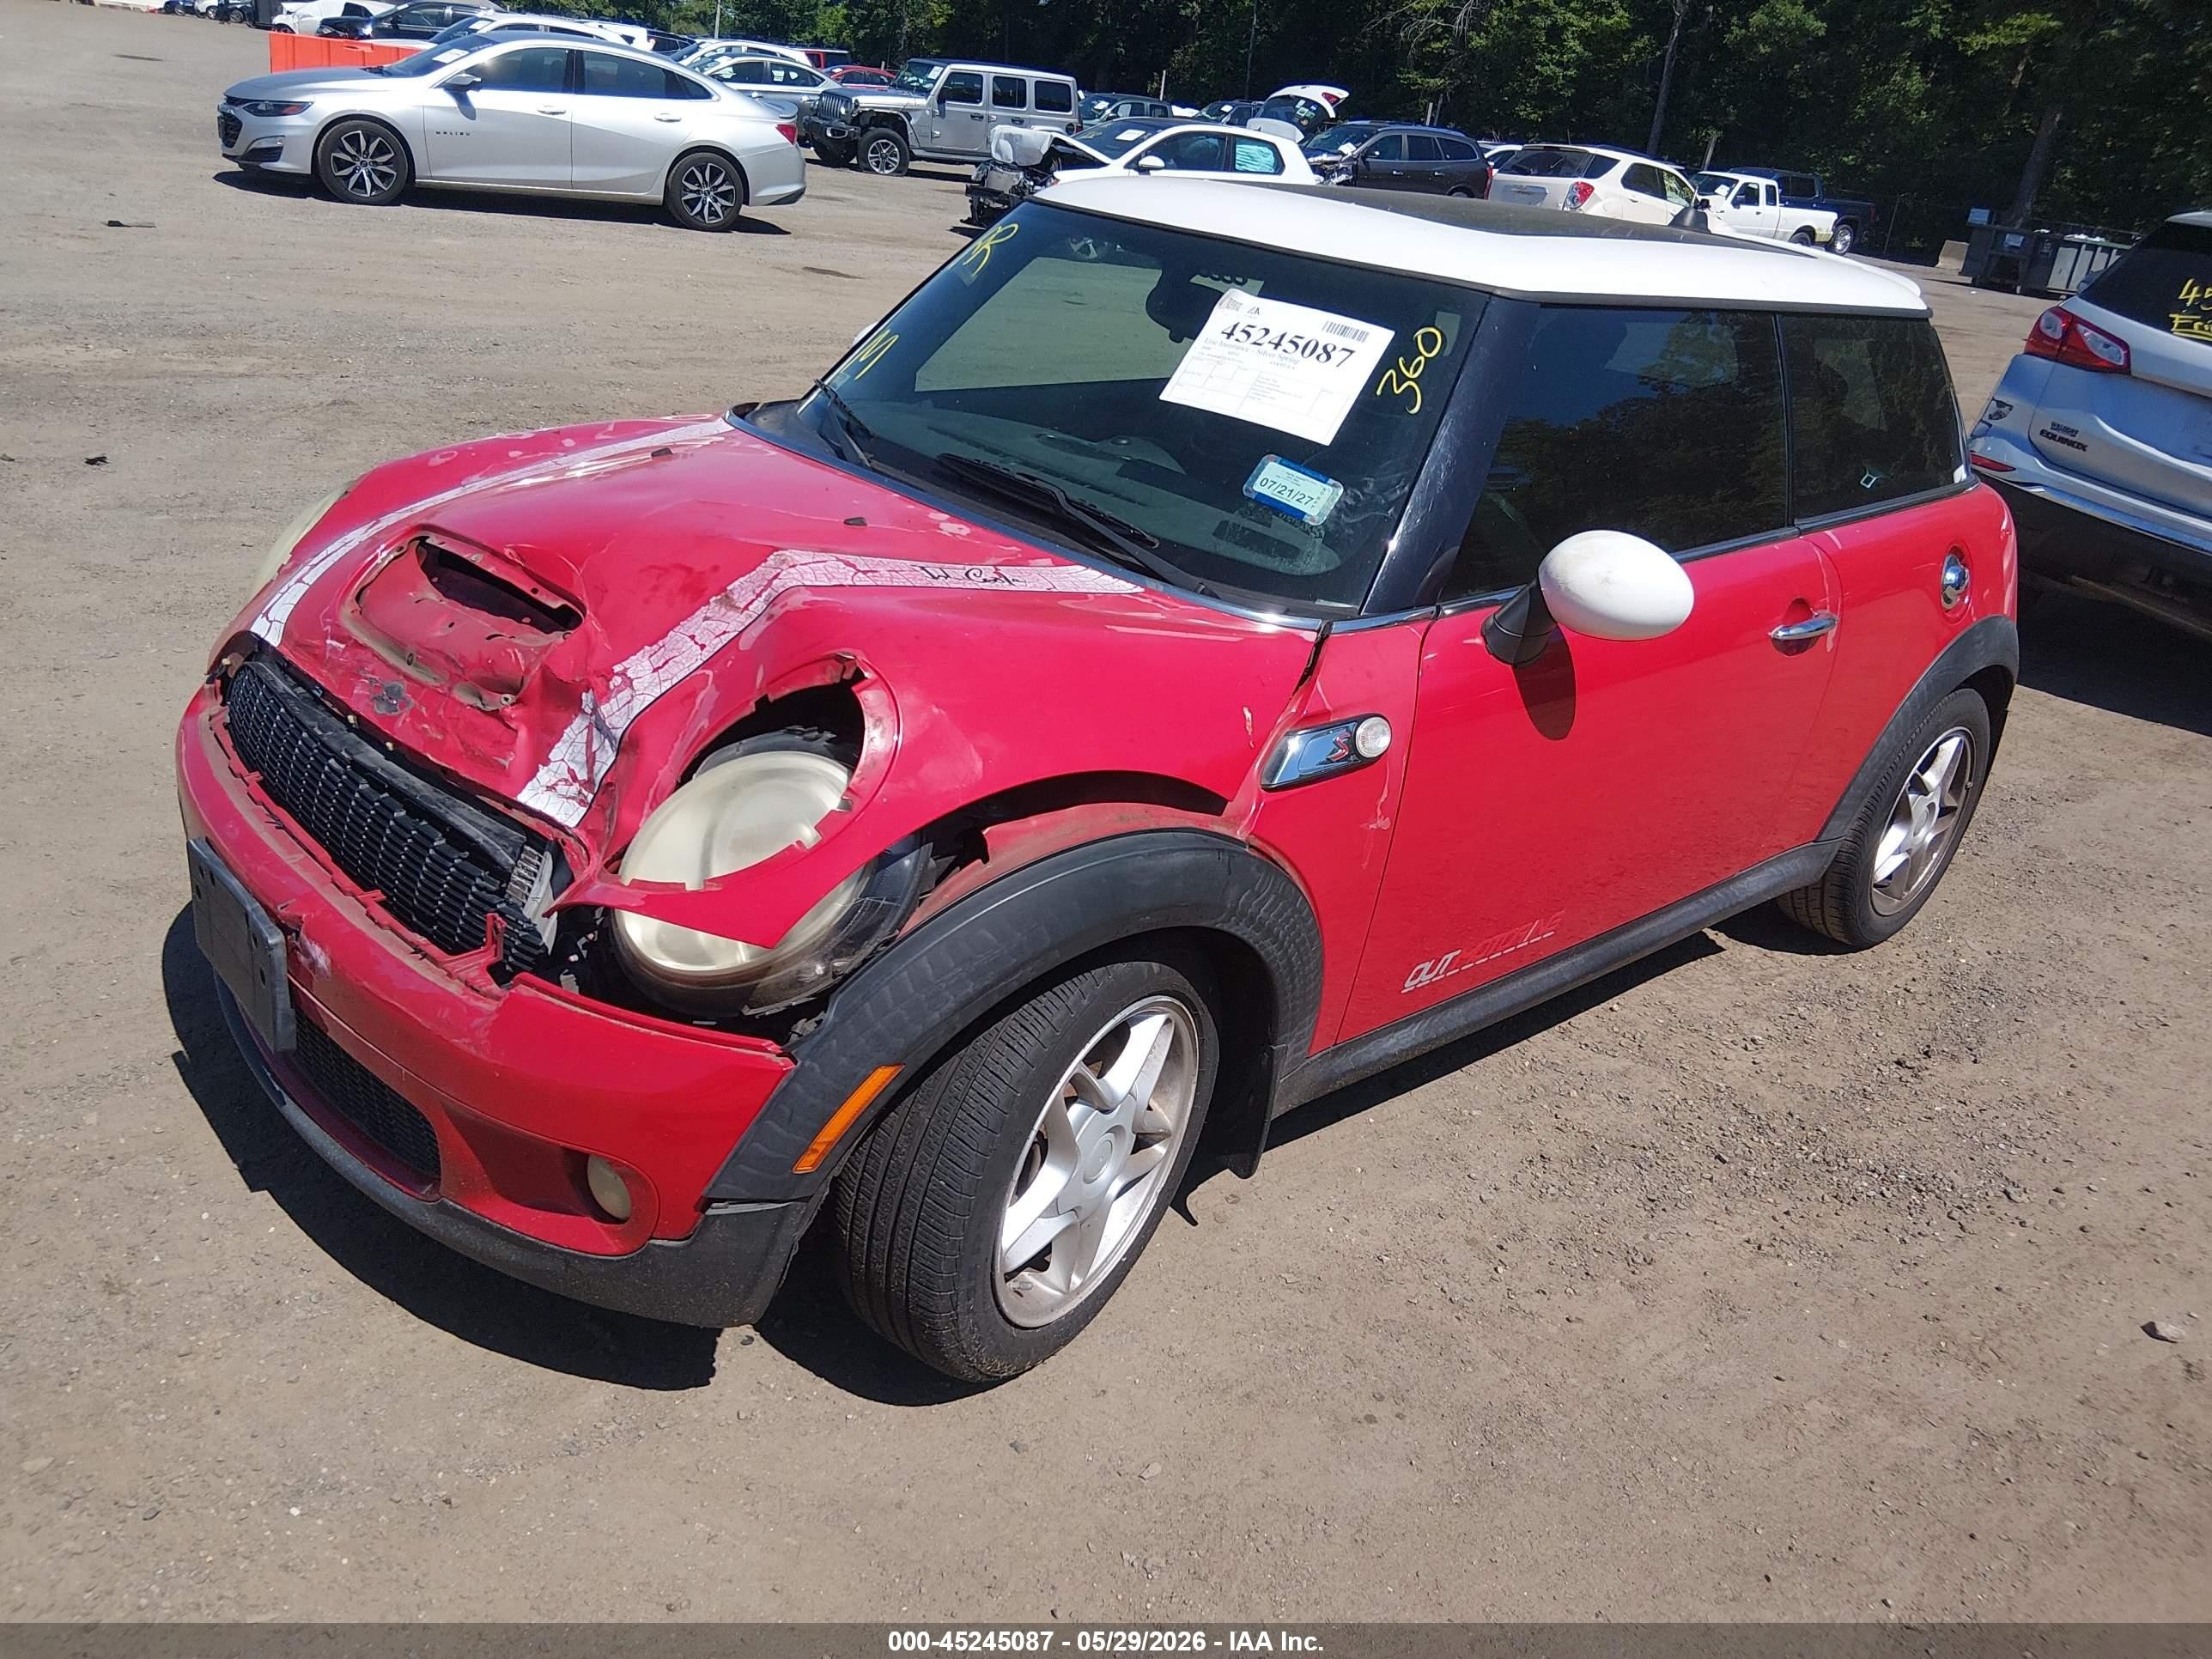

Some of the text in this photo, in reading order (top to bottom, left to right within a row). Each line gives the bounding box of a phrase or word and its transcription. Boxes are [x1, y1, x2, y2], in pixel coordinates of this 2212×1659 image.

[1221, 321, 1355, 368] 45245087
[1376, 327, 1442, 414] 360
[2039, 428, 2088, 453] EQUINOX
[1260, 477, 1314, 505] 07/21/27
[1328, 732, 1351, 761] S
